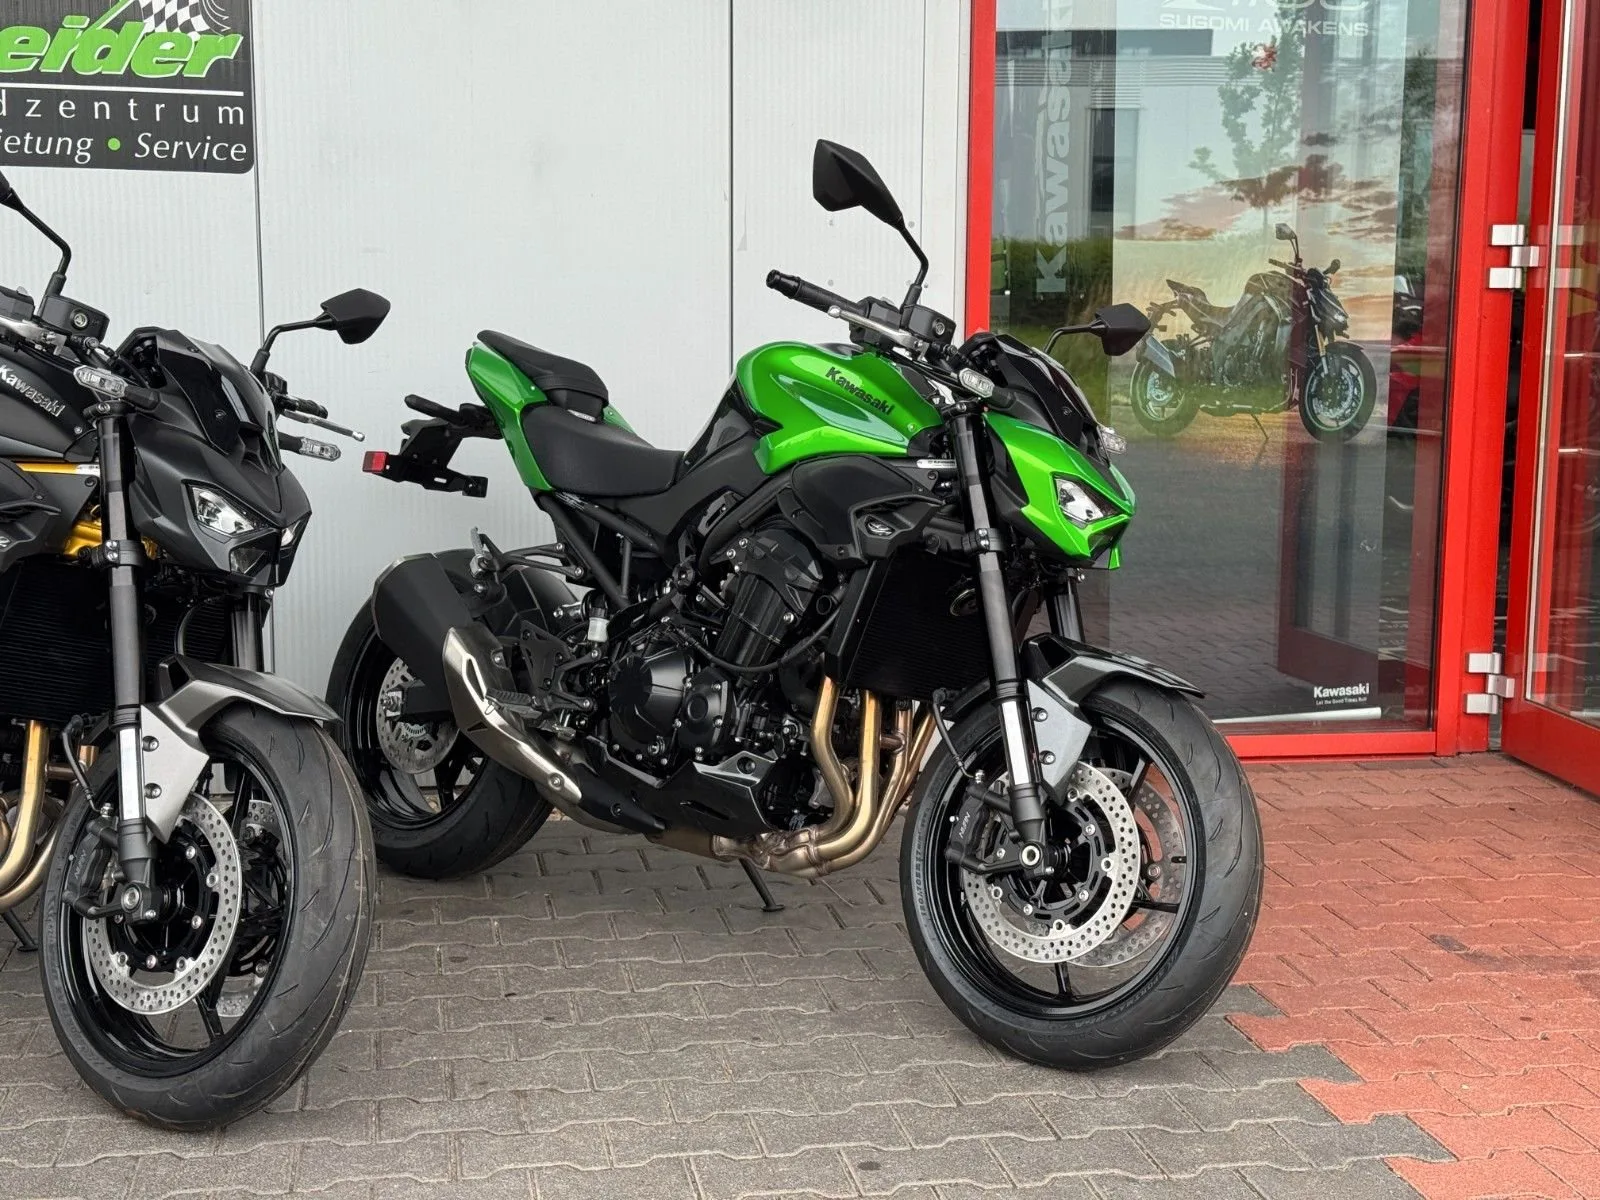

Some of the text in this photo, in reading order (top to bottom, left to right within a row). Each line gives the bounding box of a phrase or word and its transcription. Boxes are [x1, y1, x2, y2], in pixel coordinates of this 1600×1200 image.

[1160, 13, 1369, 37] SUGOMI AWAKENS
[0, 15, 243, 78] eider
[134, 132, 247, 162] Service
[0, 364, 66, 417] Kawasaki
[825, 366, 895, 415] Kawasaki
[1313, 682, 1370, 697] Kawasaki
